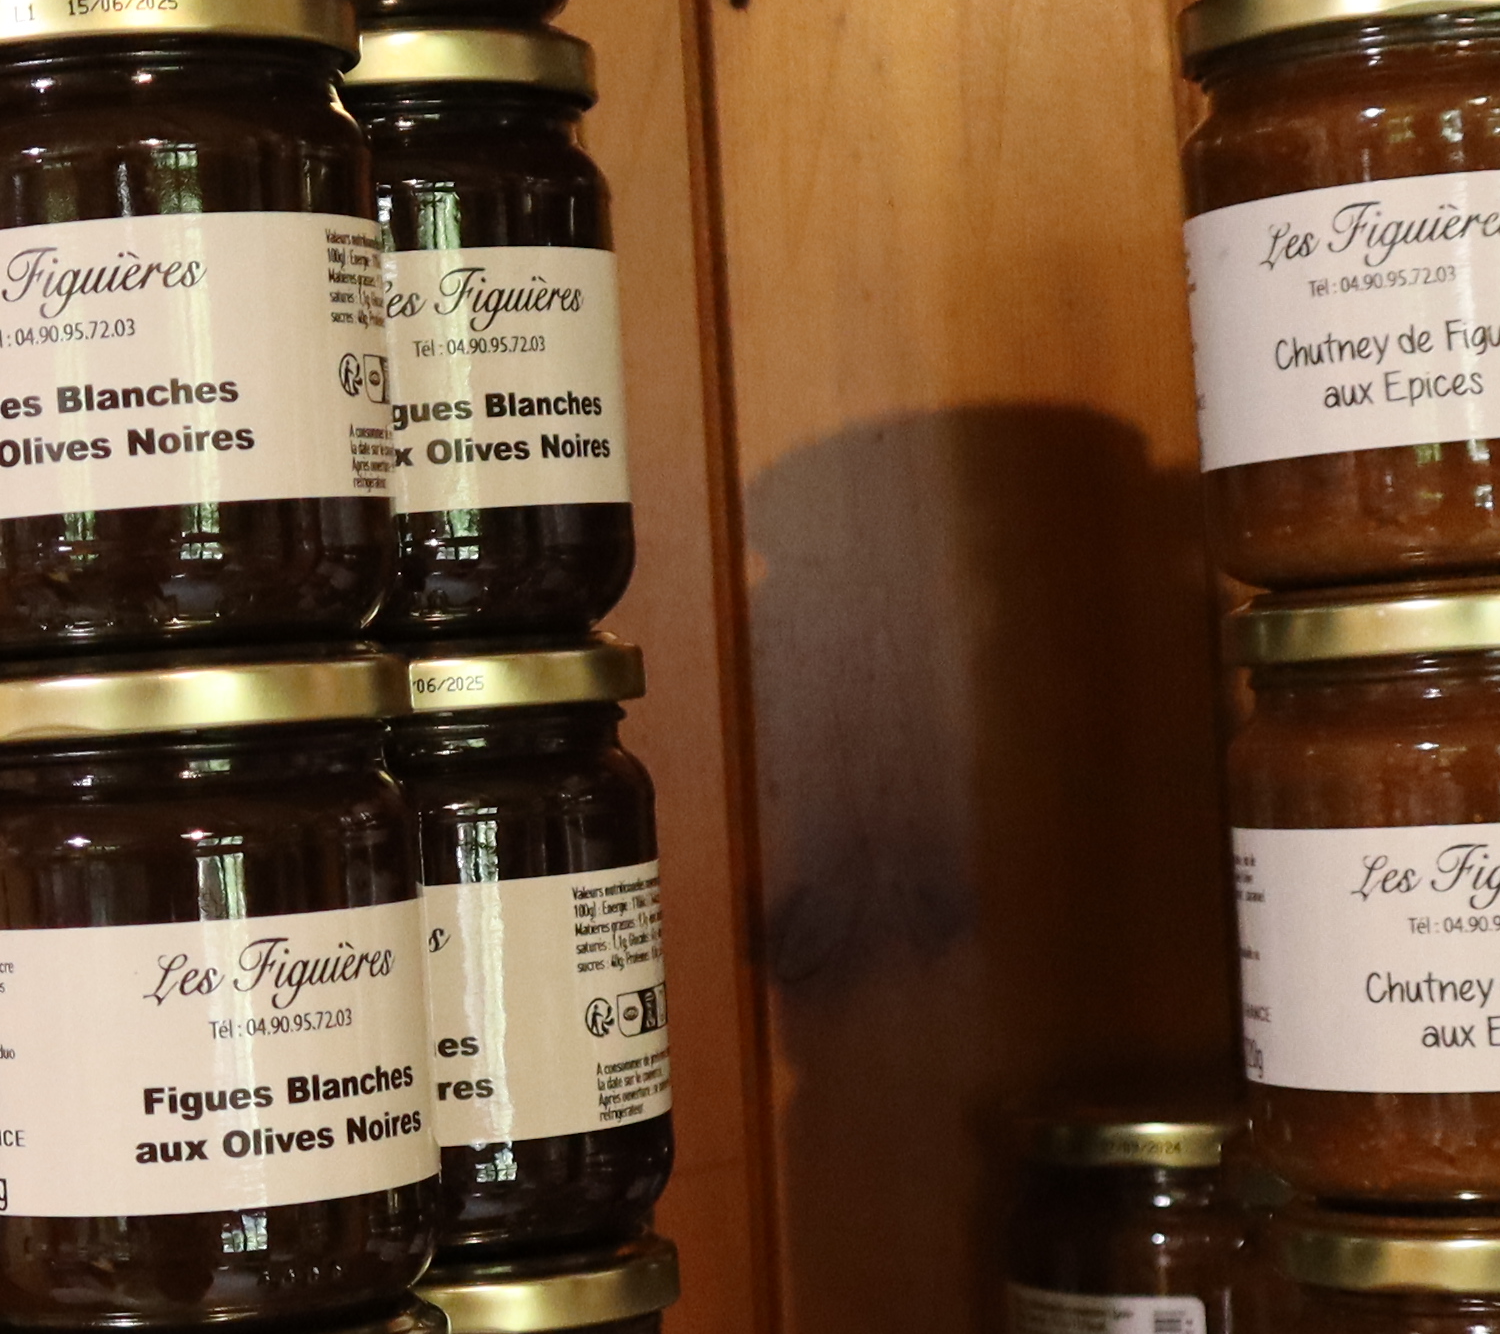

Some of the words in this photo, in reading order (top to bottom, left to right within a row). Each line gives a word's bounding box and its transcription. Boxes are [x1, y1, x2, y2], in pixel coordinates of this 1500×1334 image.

[1259, 222, 1319, 271] Les
[2, 247, 207, 319] Figuières
[14, 318, 136, 347] 04.90.95.72.03
[1275, 330, 1389, 371] Chutney
[1398, 324, 1433, 354] de
[56, 377, 240, 414] Blanches
[1323, 381, 1373, 409] aux
[1385, 370, 1484, 406] Epices
[127, 426, 255, 457] Noires
[143, 1085, 274, 1121] Figues
[287, 1064, 414, 1105] Blanches
[135, 1136, 209, 1164] aux
[222, 1127, 334, 1159] Olives
[346, 1107, 422, 1147] Noires
